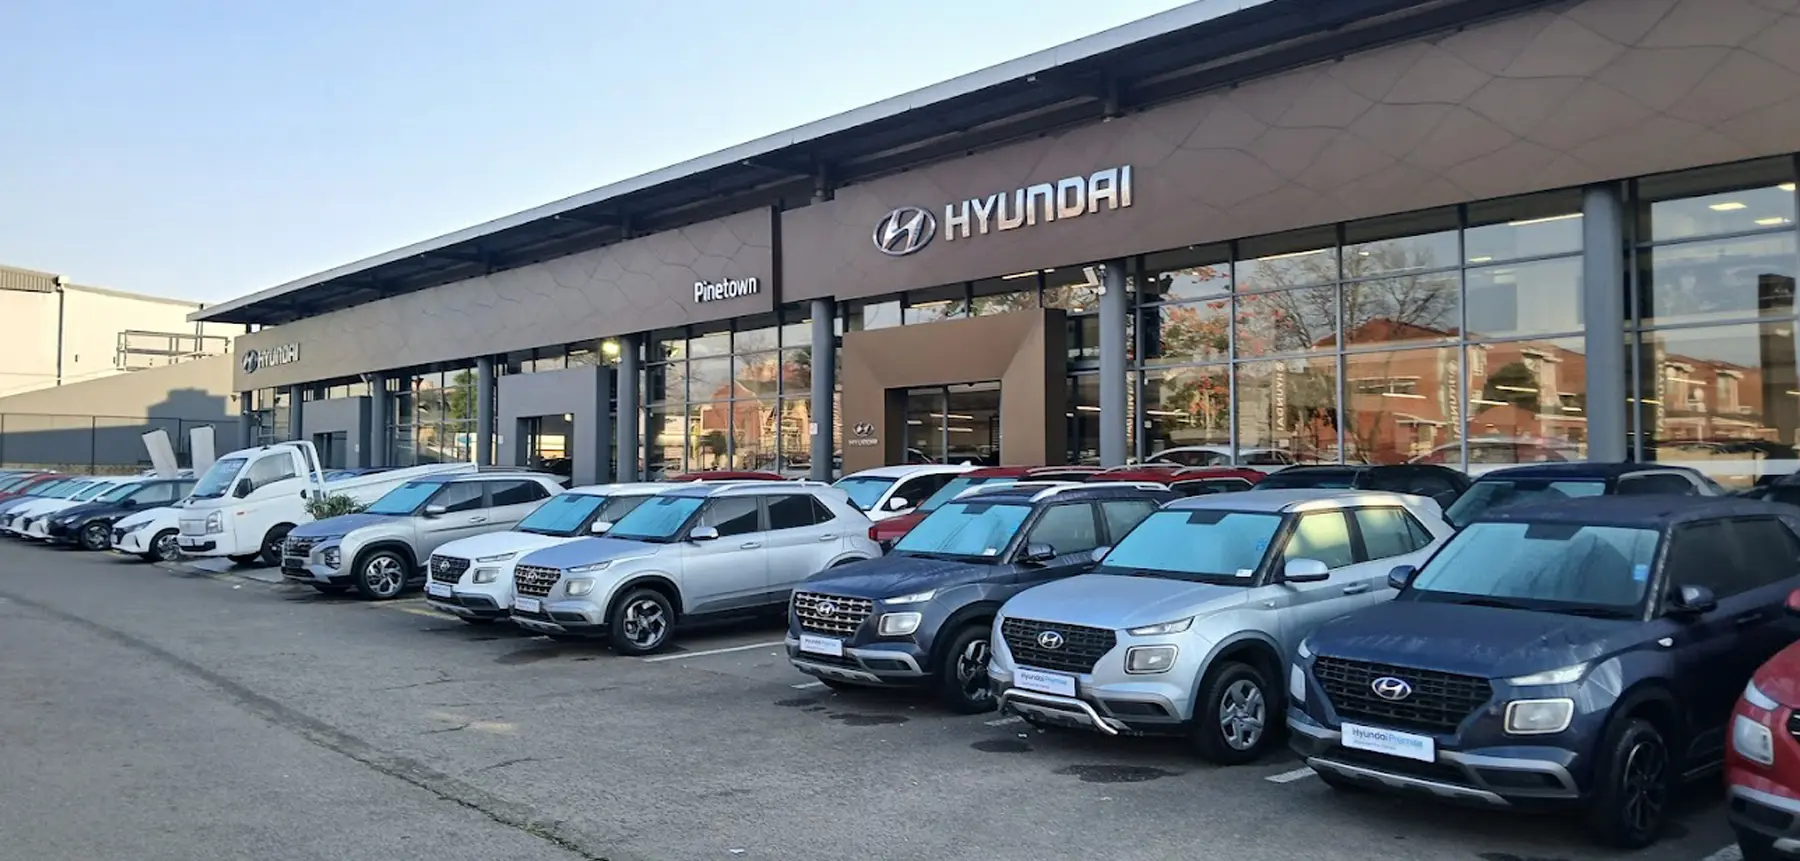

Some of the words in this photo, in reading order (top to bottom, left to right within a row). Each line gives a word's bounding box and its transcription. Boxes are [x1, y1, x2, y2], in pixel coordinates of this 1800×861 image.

[945, 165, 1132, 241] HYUNDAI
[694, 277, 758, 303] Pinetown
[258, 342, 300, 368] HYUNDAI
